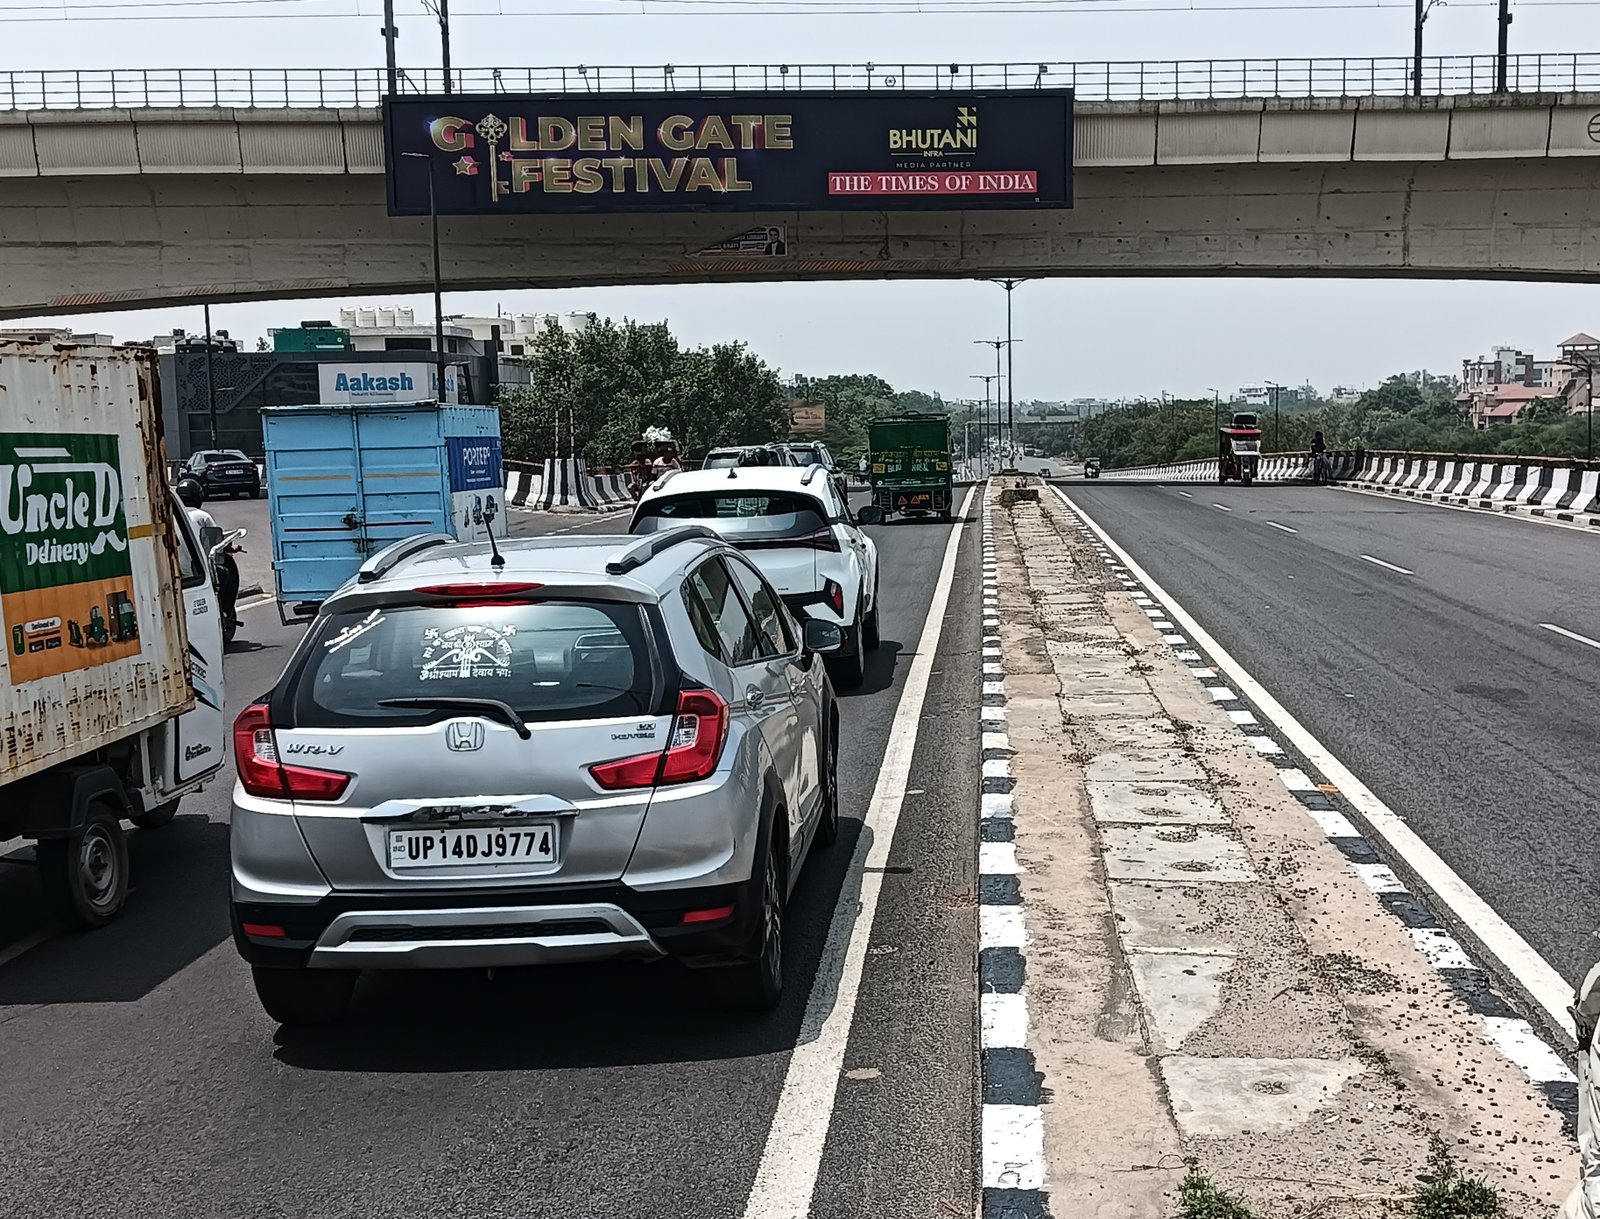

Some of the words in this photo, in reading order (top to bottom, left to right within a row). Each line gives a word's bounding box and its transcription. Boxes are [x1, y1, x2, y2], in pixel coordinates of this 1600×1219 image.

[657, 114, 794, 151] GATE
[889, 128, 978, 149] BHUTANI
[923, 150, 944, 158] INFRA
[896, 161, 926, 169] MEDIA
[929, 161, 972, 169] PARTNER
[511, 156, 753, 194] FESTIVAL
[830, 175, 872, 192] THE
[877, 175, 939, 192] TIMES
[945, 175, 973, 191] OF
[978, 174, 1034, 191] INDIA
[335, 372, 414, 391] Aakash
[286, 743, 344, 755] WR-V
[407, 831, 551, 861] UP14DJ9774
